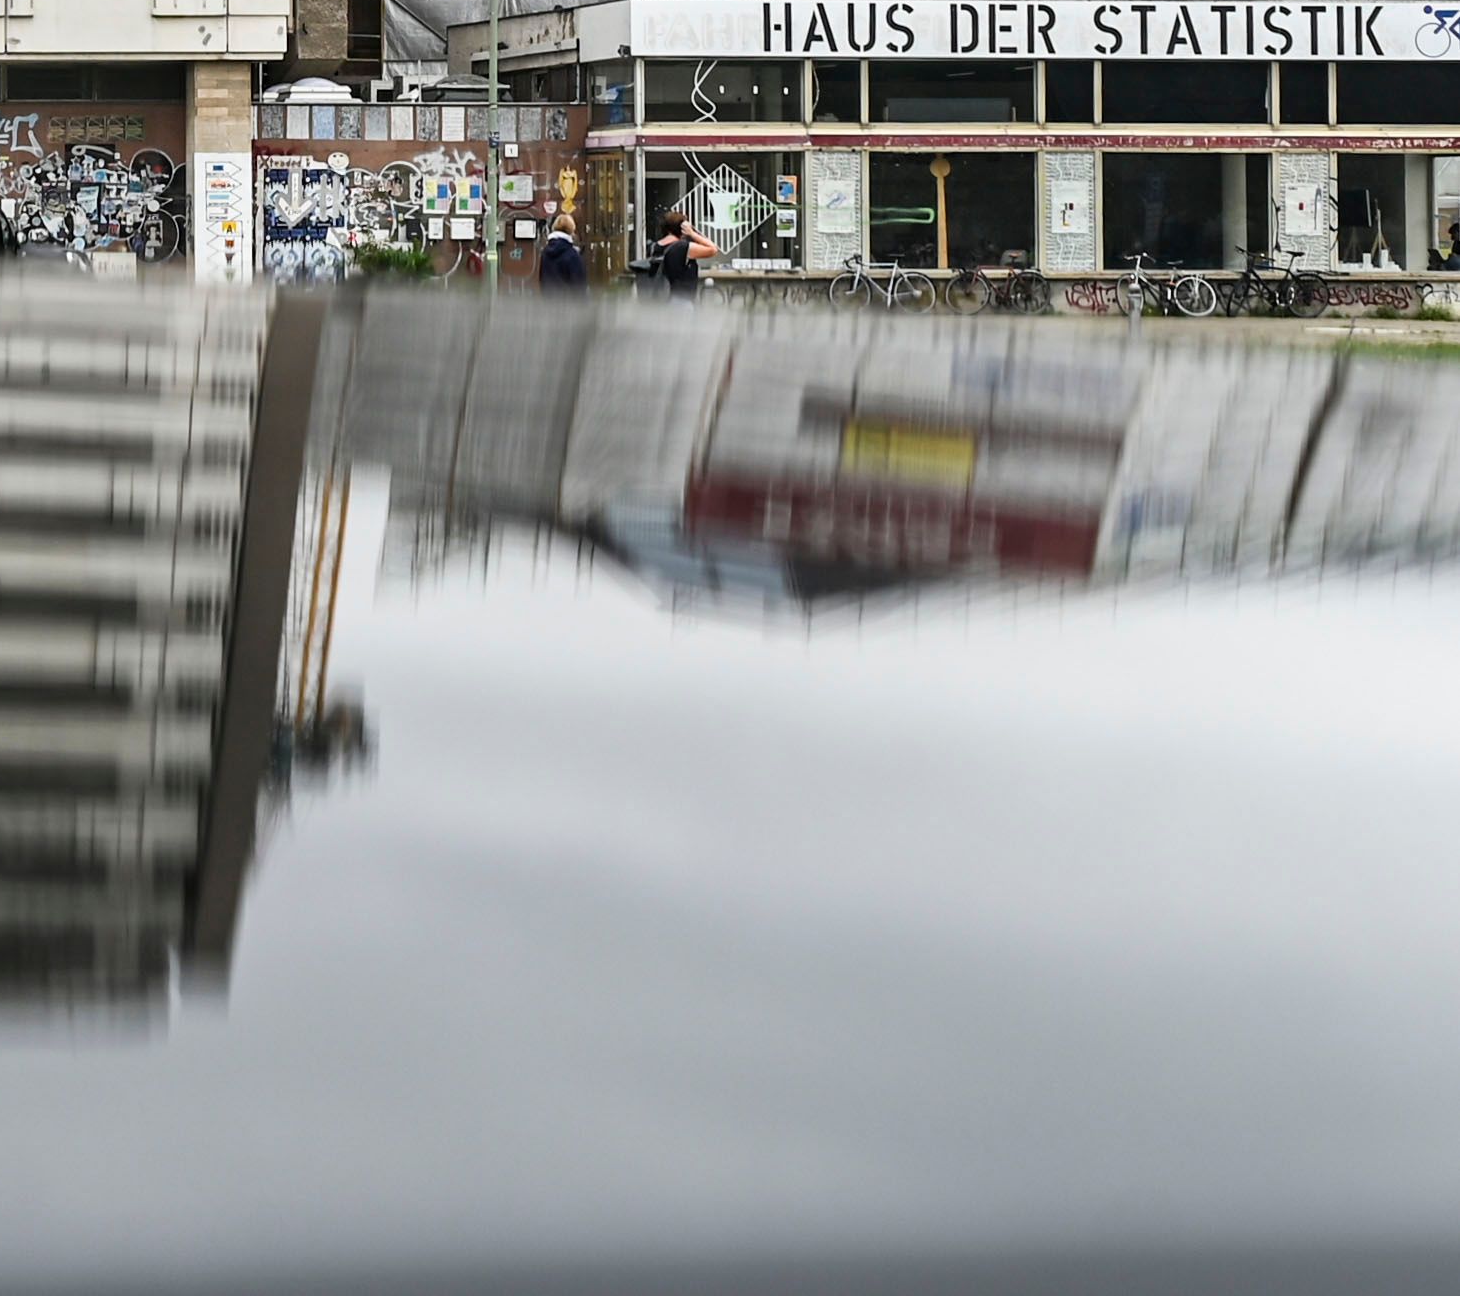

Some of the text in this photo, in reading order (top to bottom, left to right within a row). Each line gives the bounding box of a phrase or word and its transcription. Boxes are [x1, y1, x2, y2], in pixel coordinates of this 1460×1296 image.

[763, 3, 915, 53] HAUS
[951, 4, 1056, 54] DER
[1093, 4, 1384, 55] STATISTIK
